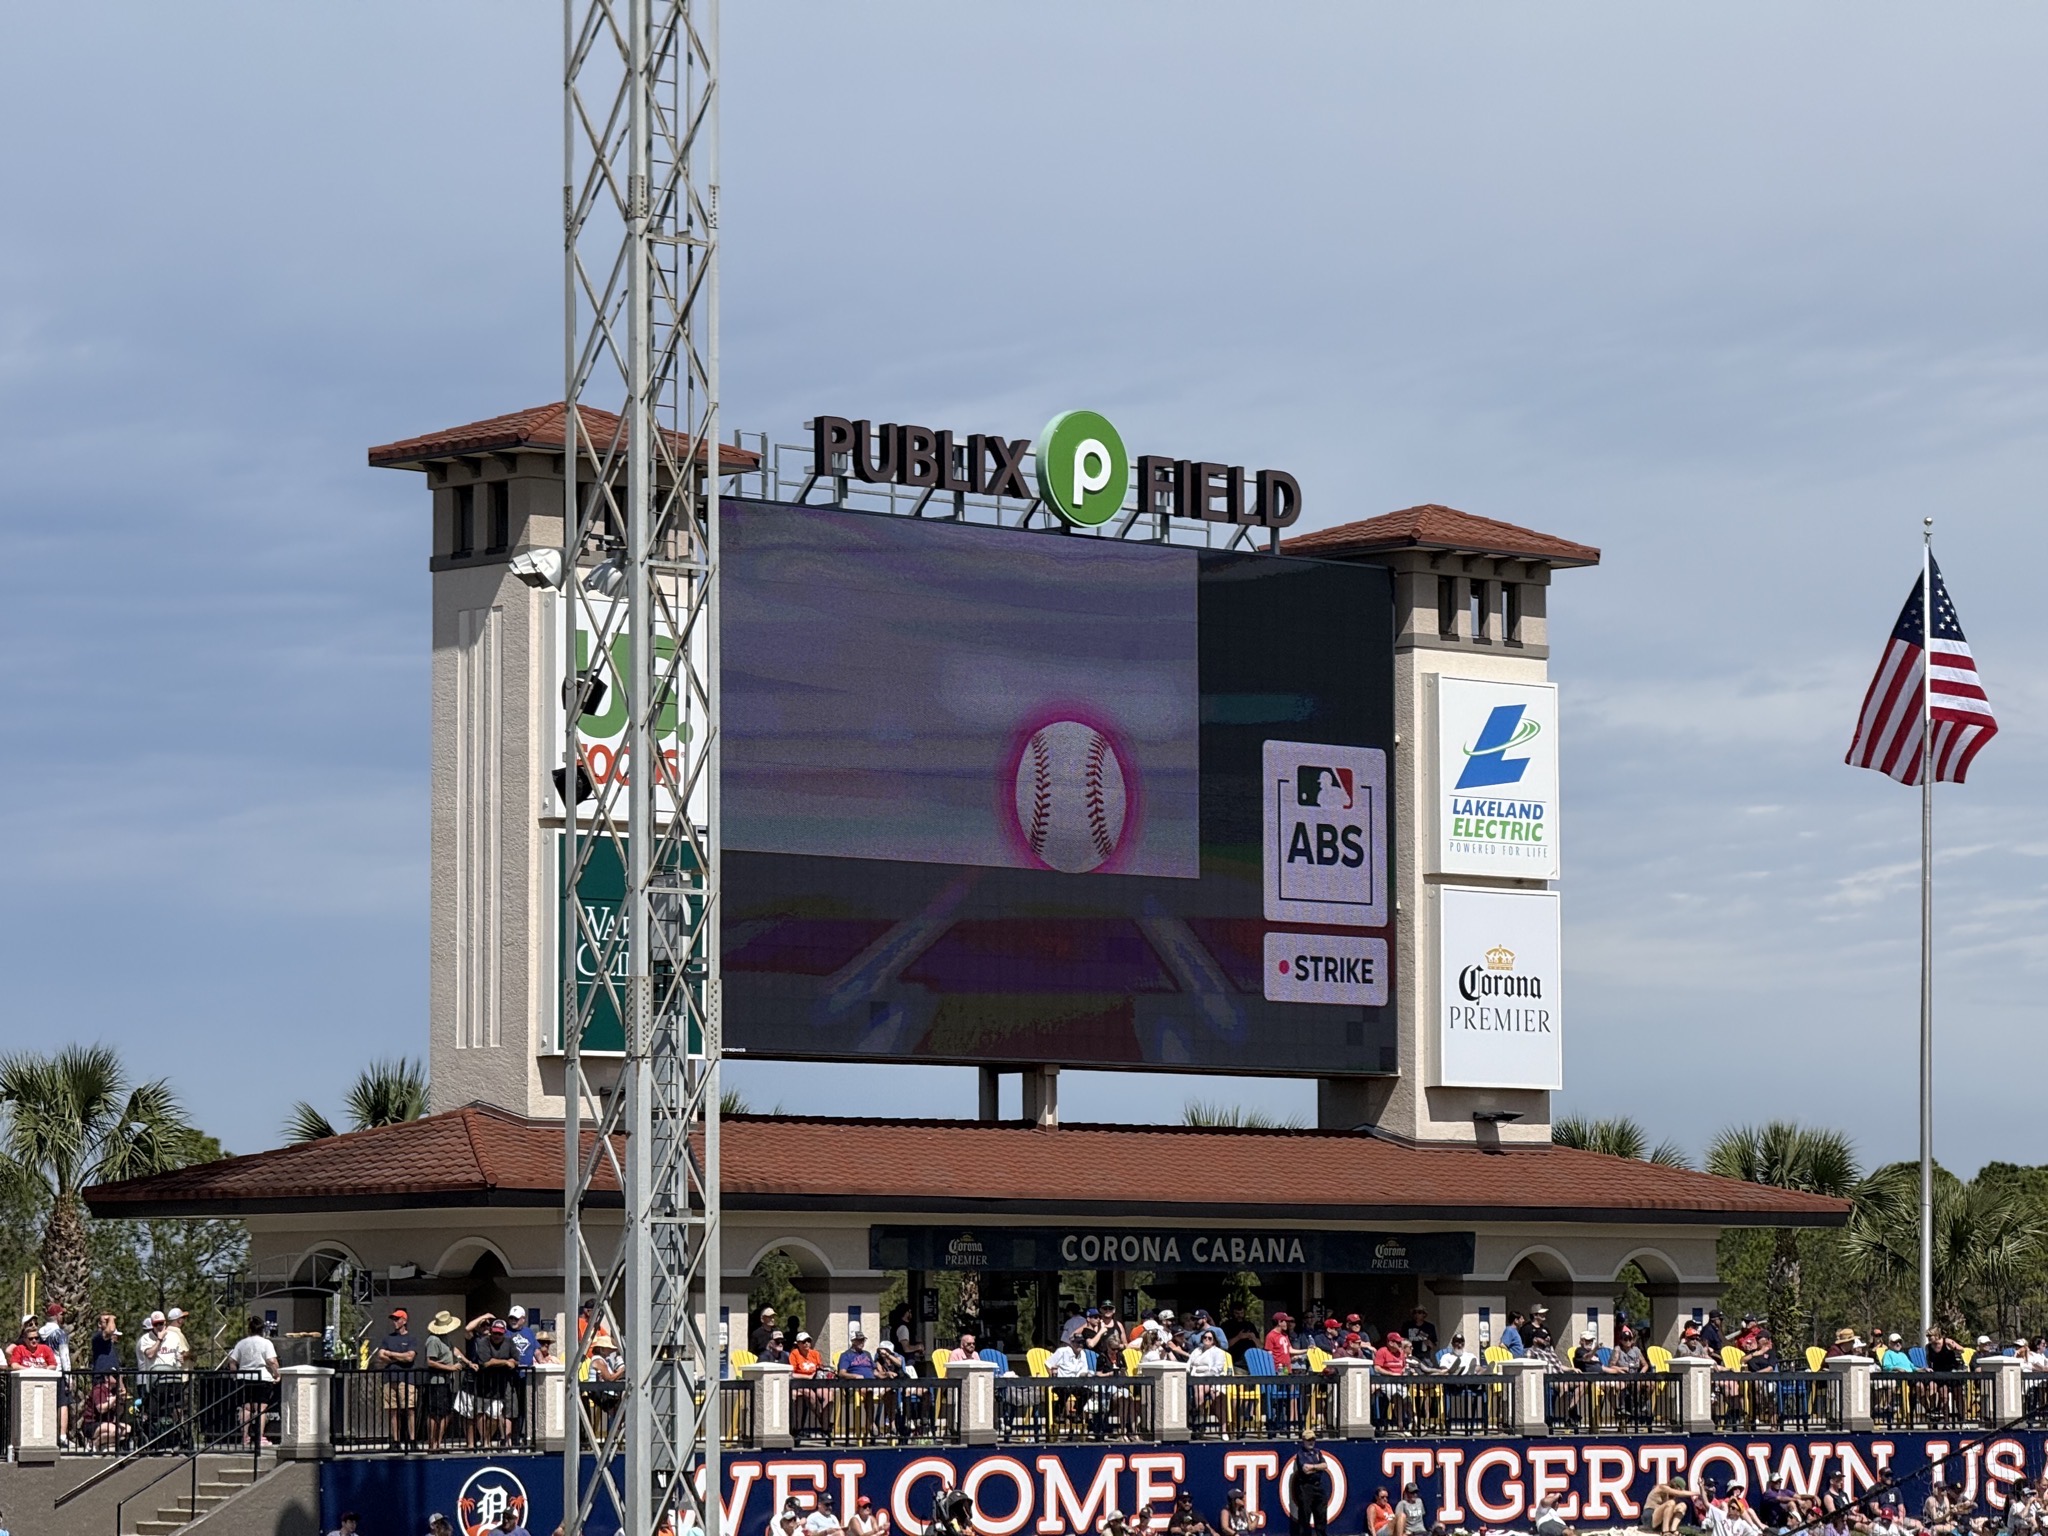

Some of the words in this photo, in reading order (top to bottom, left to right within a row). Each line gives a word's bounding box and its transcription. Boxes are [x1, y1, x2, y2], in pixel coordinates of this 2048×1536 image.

[814, 415, 1032, 499] PUBLIX
[1138, 455, 1302, 527] FIELD
[1452, 798, 1544, 820] LAKELAND
[1453, 817, 1544, 842] ELECTRIC
[1287, 821, 1364, 868] ABS
[1449, 841, 1496, 855] POWERED
[1502, 845, 1521, 856] FOR
[1526, 847, 1548, 859] LIFE
[1294, 955, 1374, 984] STRIKE
[1458, 963, 1542, 1006] Corona
[1449, 1005, 1551, 1033] PREMIER
[945, 1254, 989, 1266] PREMIER
[949, 1238, 983, 1256] Corona
[1061, 1235, 1181, 1263] CORONA
[1191, 1236, 1306, 1264] CABANA
[1374, 1244, 1407, 1260] Corona
[1371, 1258, 1410, 1269] PREMIER
[1224, 1449, 1347, 1529] TO
[1382, 1440, 1895, 1523] TIGERTOWN
